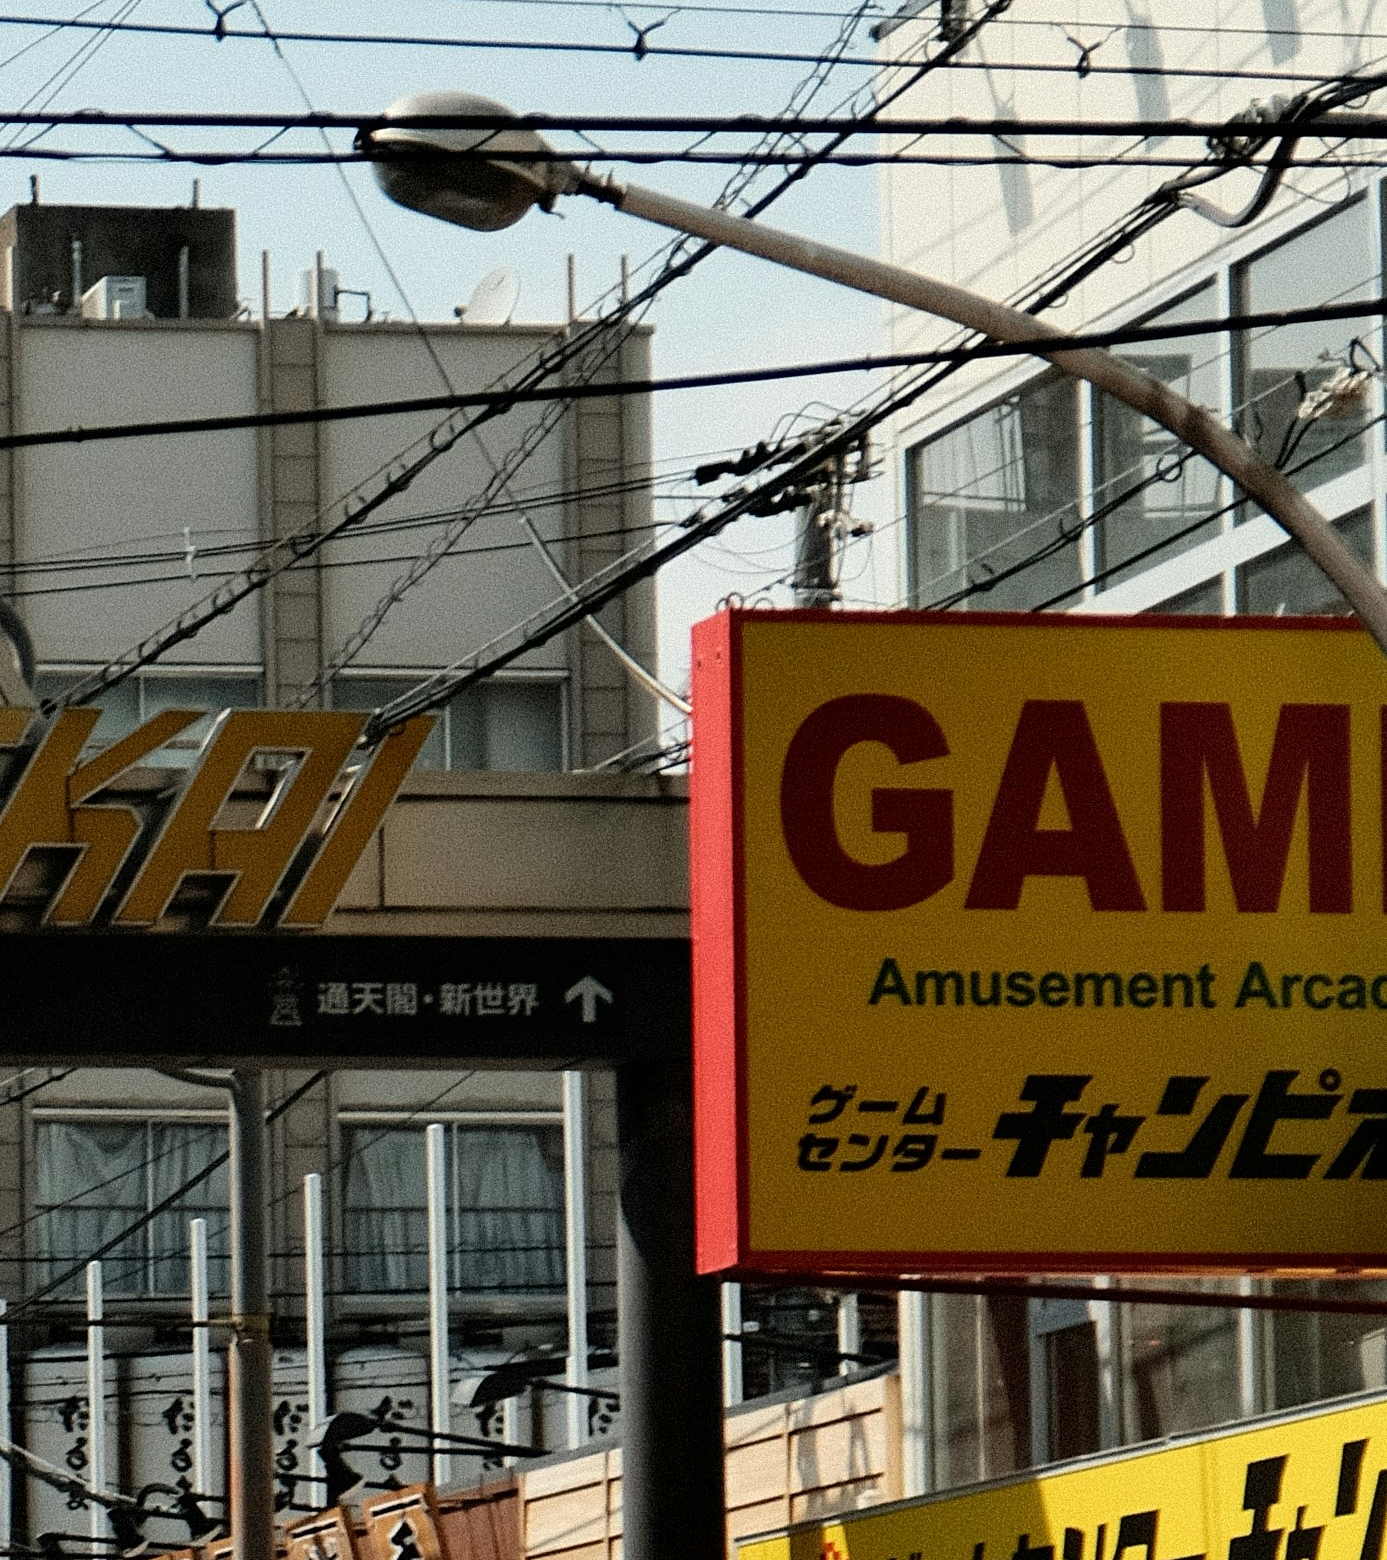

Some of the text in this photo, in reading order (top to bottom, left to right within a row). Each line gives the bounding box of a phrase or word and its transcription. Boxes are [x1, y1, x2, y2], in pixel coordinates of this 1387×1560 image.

[779, 692, 1387, 914] GAM
[317, 982, 539, 1016] 通天閣・新世界
[867, 959, 1217, 1010] Amusement
[809, 1083, 949, 1127] ゲーム
[797, 1134, 982, 1173] センター
